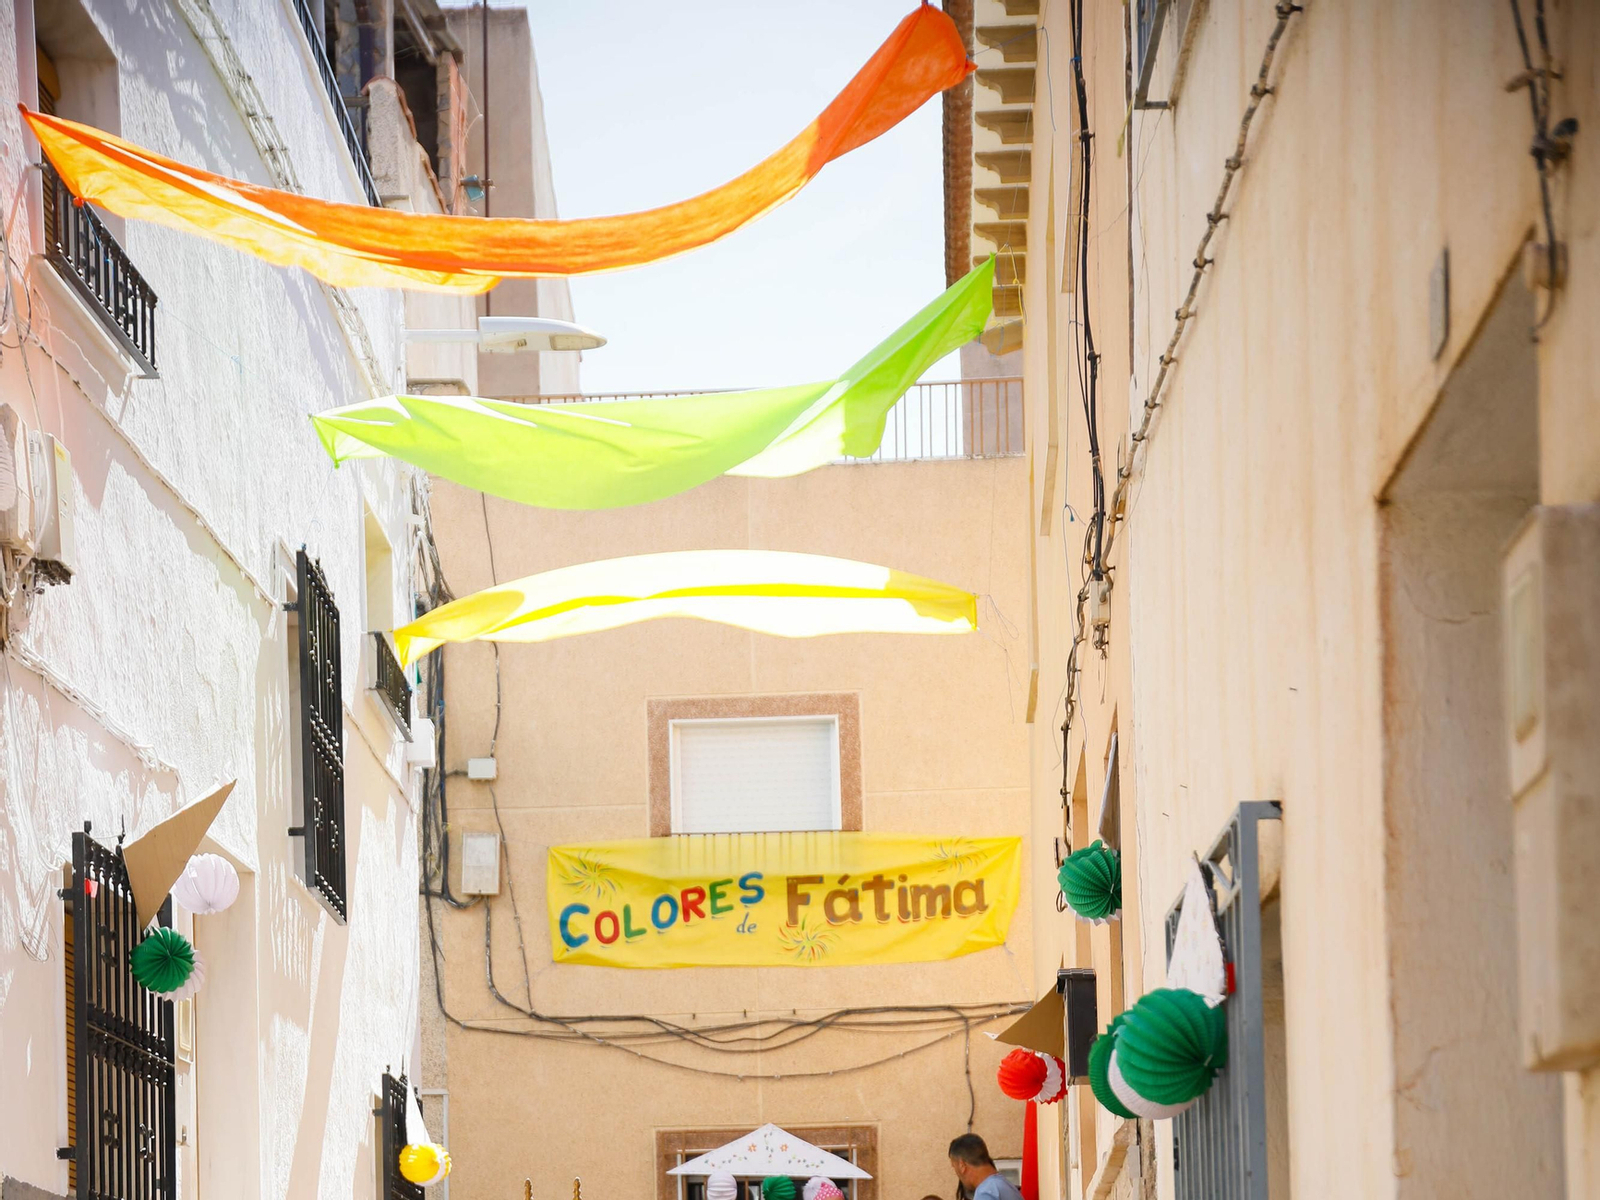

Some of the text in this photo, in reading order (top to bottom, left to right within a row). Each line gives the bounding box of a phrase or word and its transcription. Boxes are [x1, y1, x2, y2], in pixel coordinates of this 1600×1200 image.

[559, 871, 988, 949] COLORES de Fátima
